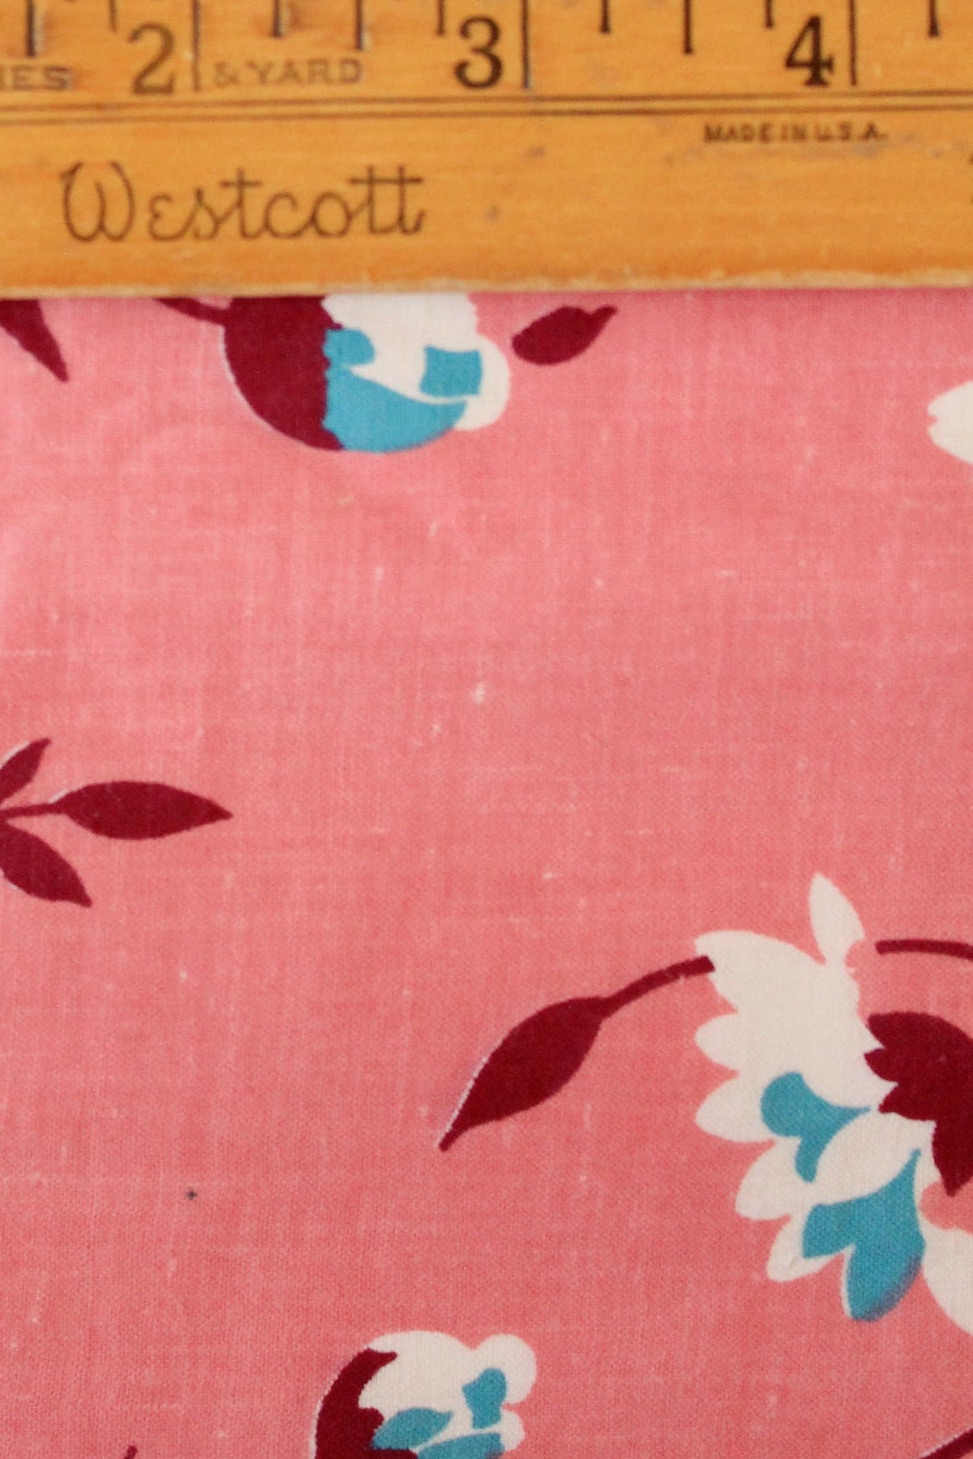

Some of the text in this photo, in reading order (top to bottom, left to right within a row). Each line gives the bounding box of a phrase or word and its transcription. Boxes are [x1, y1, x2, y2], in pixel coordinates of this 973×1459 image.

[129, 21, 177, 96] 2
[212, 60, 241, 88] &
[245, 57, 363, 87] YARD
[453, 15, 504, 88] 3
[785, 15, 835, 87] 4
[703, 122, 772, 144] MADE
[781, 122, 808, 143] IN
[58, 160, 426, 243] Westcott
